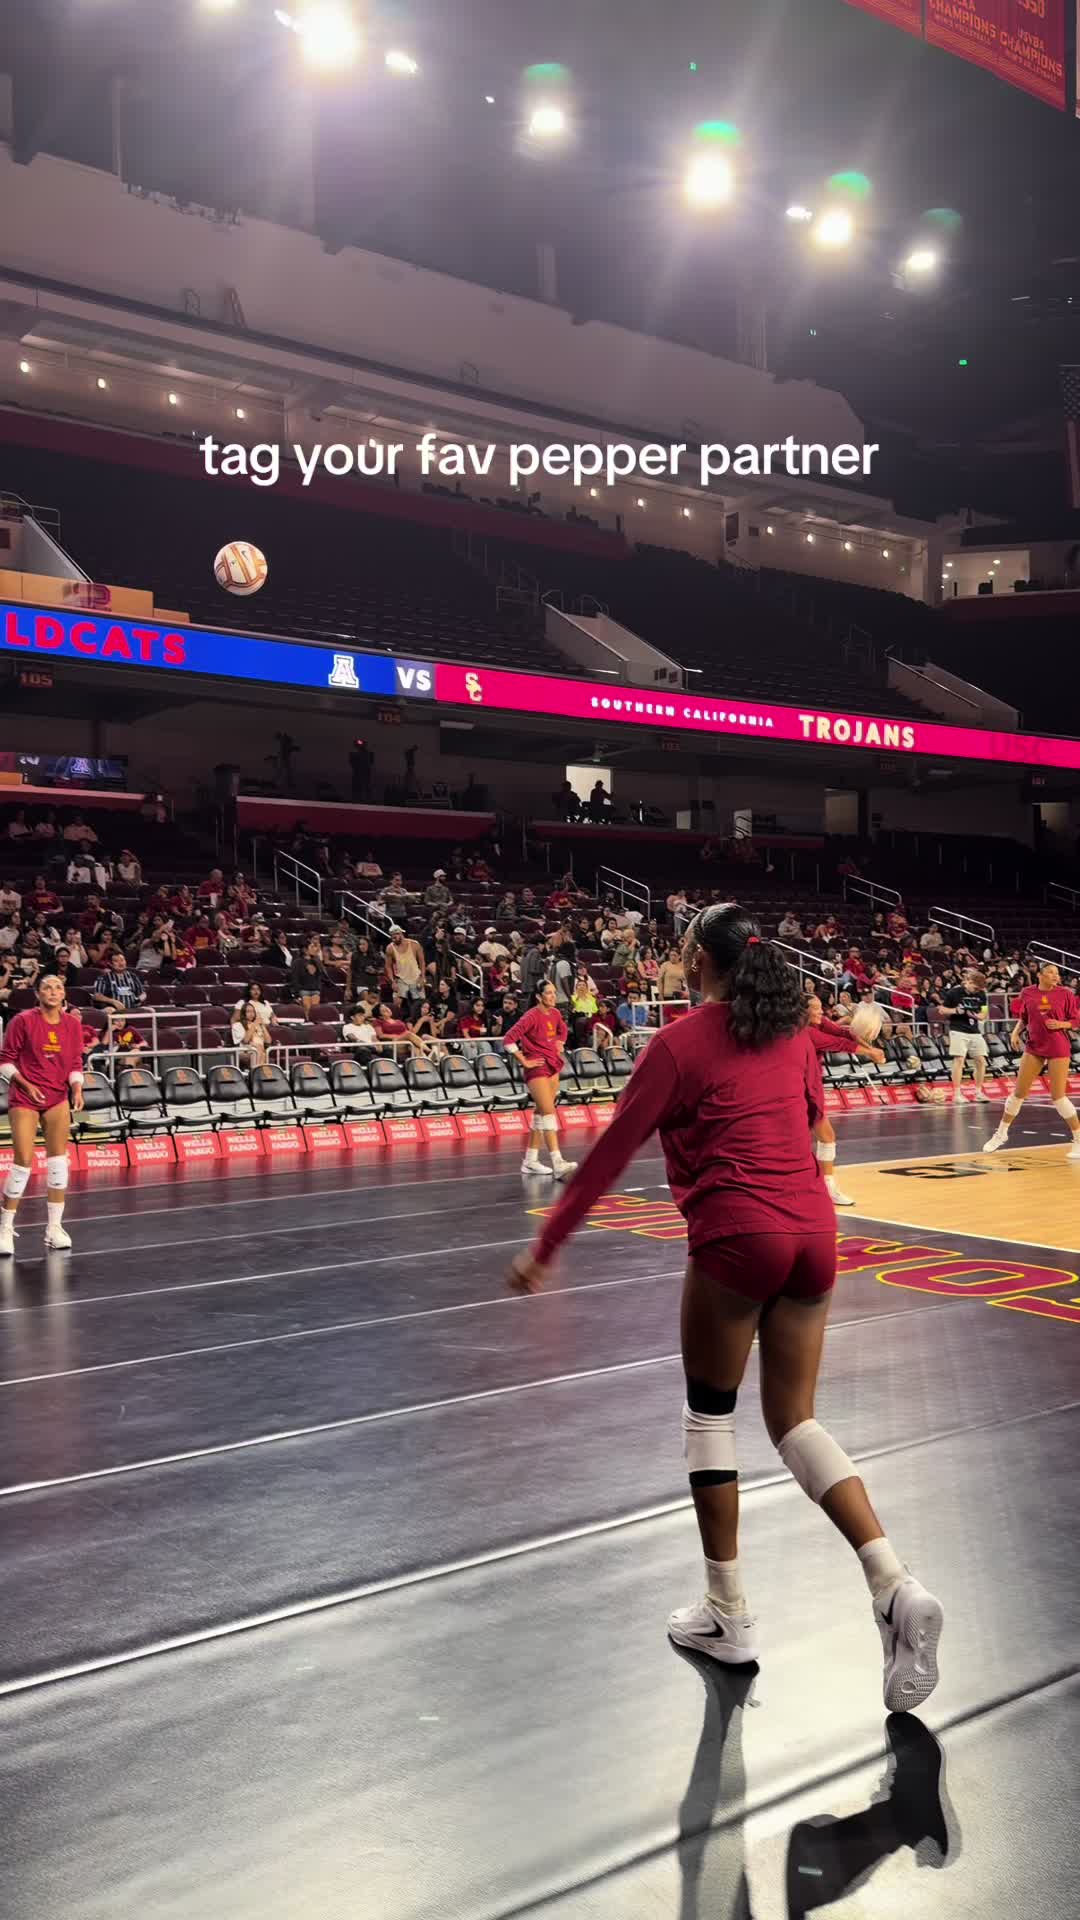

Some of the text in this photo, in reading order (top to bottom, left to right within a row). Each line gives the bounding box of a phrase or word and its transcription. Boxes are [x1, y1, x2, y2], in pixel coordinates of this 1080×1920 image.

[999, 31, 1063, 77] CHAMPIONS
[6, 613, 186, 664] LDCATS
[20, 671, 53, 687] 105
[328, 654, 359, 688] A
[396, 666, 432, 691] VS
[591, 696, 774, 728] SOUTHERN CALIFORNIA
[798, 714, 915, 749] TROJANS
[135, 1142, 167, 1151] WELLS
[183, 1138, 213, 1147] WELLS
[227, 1135, 256, 1144] WELLS
[86, 1149, 120, 1158] WELLS
[137, 1151, 168, 1160] FARGO
[185, 1147, 215, 1156] FARGO
